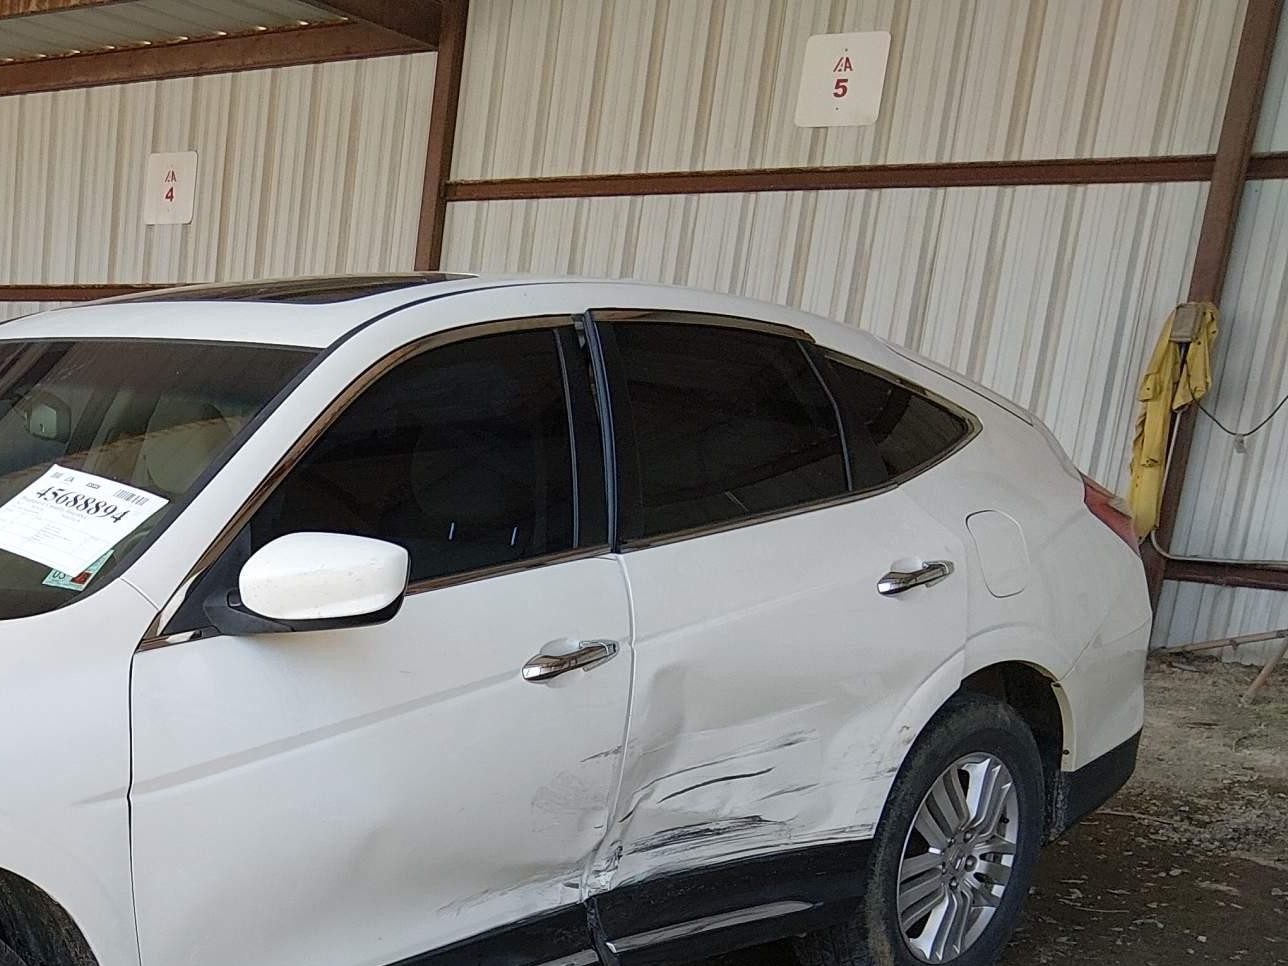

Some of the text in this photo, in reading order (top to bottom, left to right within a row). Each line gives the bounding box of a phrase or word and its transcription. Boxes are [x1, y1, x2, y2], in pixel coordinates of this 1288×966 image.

[832, 78, 849, 98] 5
[165, 186, 174, 202] 4
[36, 486, 130, 523] 45688894
